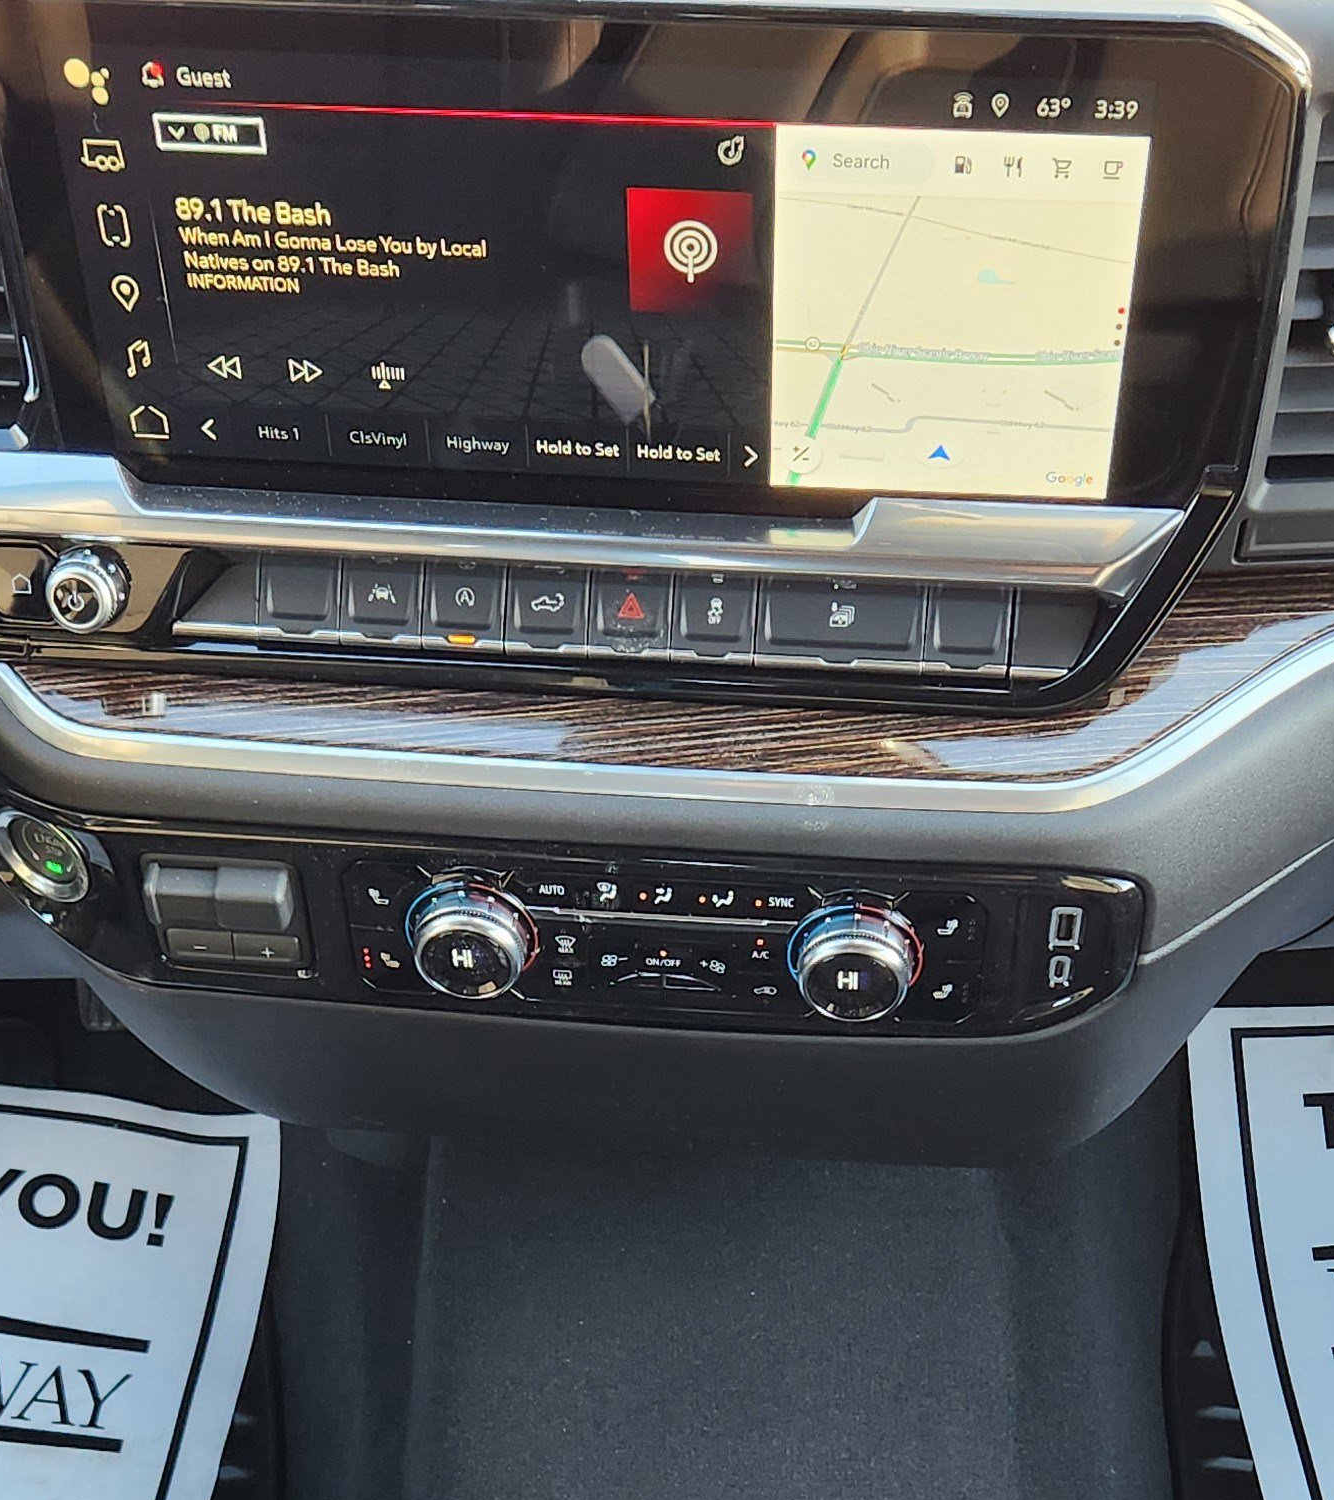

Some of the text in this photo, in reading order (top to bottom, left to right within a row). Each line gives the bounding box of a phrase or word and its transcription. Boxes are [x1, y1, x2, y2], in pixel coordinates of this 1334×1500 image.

[176, 65, 232, 89] Guest
[1036, 97, 1072, 118] 63°
[1094, 98, 1139, 120] 3:39
[212, 123, 238, 144] FM
[832, 152, 890, 171] Search
[175, 197, 332, 227] 89.1 The Bash
[178, 226, 229, 248] When
[231, 229, 262, 249] Am
[273, 232, 332, 252] Gonna
[335, 234, 378, 254] Lose
[378, 235, 413, 256] You
[415, 237, 438, 260] by
[440, 238, 488, 259] Local
[183, 251, 400, 279] Natives on 89.1 The Bash
[186, 272, 301, 295] INFORMATION
[257, 425, 301, 441] Hits 1
[349, 430, 408, 448] ClsVinyl
[446, 435, 511, 456] Highway
[536, 439, 621, 458] Hold to Set
[636, 444, 722, 463] Hold to Set
[1045, 470, 1095, 487] Google
[538, 884, 565, 895] AUTO
[768, 896, 794, 908] SYNC
[451, 948, 474, 969] HI
[645, 957, 682, 967] ON/OFF
[751, 950, 770, 960] A/C
[837, 970, 859, 990] HI
